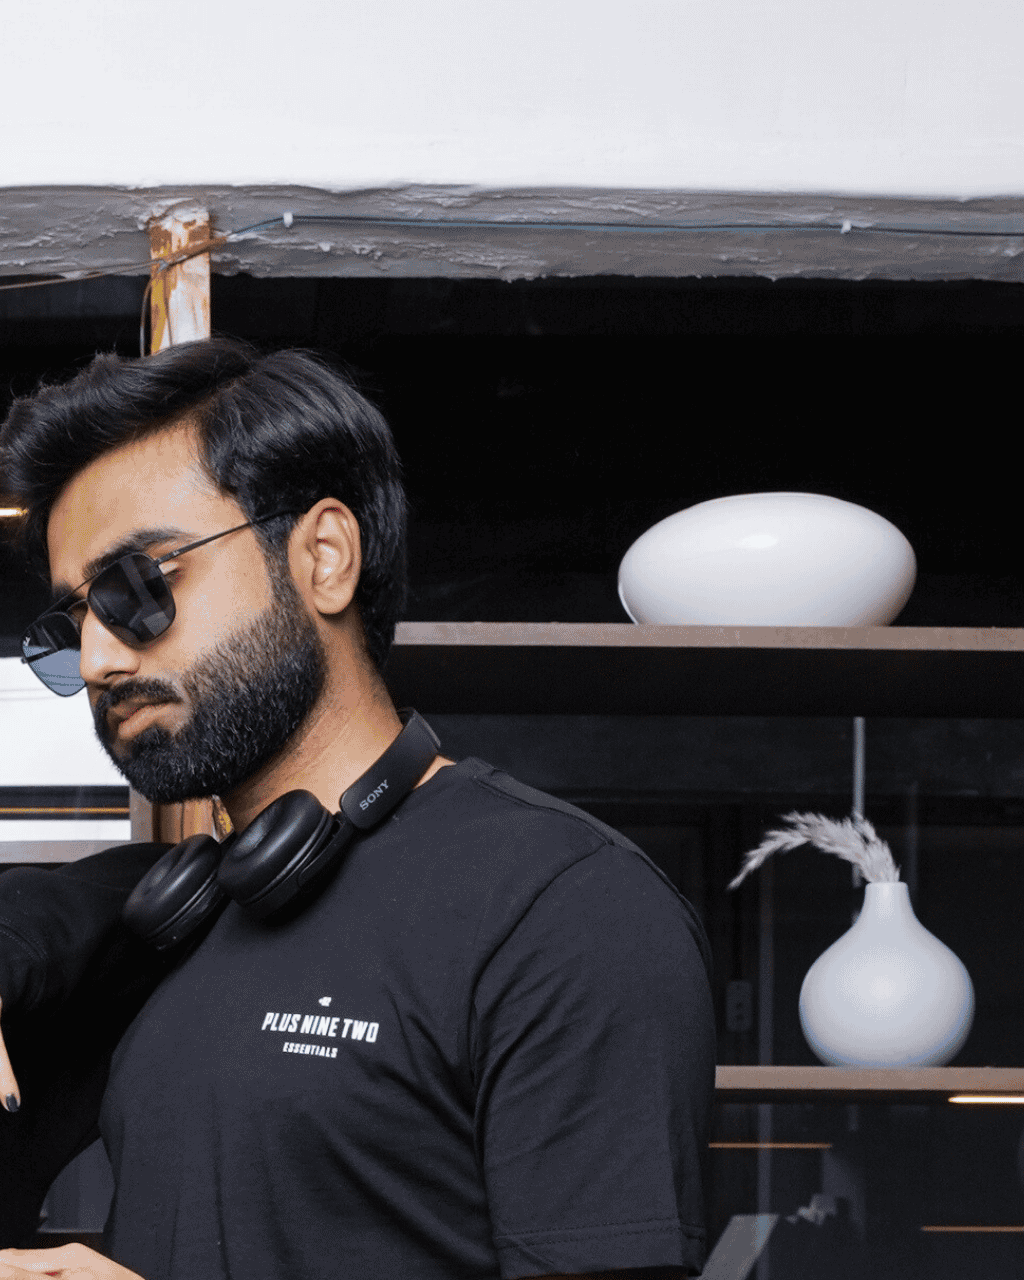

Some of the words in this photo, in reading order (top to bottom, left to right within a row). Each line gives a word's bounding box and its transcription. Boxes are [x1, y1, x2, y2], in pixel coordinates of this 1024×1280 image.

[359, 779, 389, 811] SONY
[261, 1012, 302, 1032] PLUS
[300, 1015, 340, 1038] NINE
[341, 1018, 380, 1043] TWO
[283, 1042, 338, 1058] ESSENTIALS
